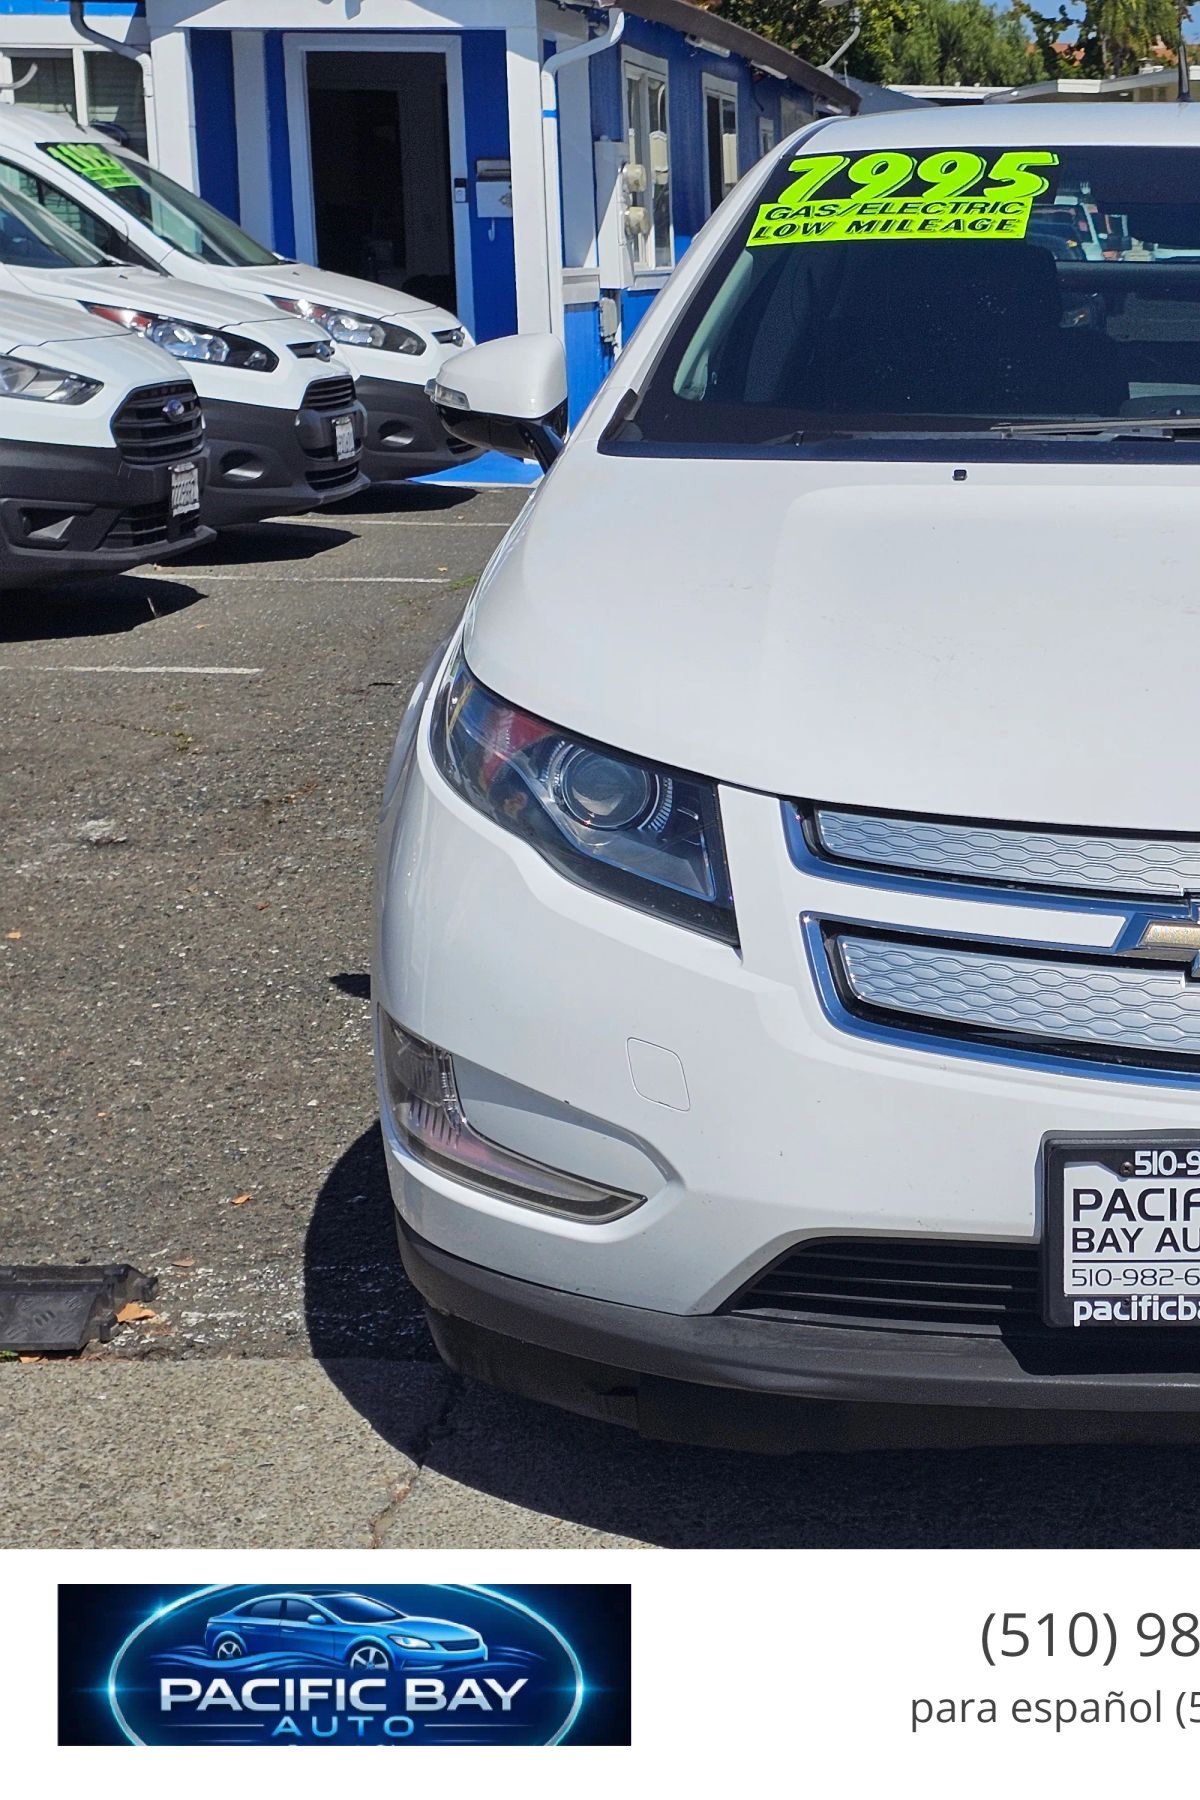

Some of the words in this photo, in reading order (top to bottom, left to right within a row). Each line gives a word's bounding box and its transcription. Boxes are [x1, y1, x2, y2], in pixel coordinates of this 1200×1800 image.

[777, 151, 1060, 204] 7995
[764, 201, 1025, 221] GAS/ELECTRIC
[752, 222, 831, 240] LOW
[845, 218, 1020, 234] MILEAGE
[1072, 1226, 1144, 1254] BAY
